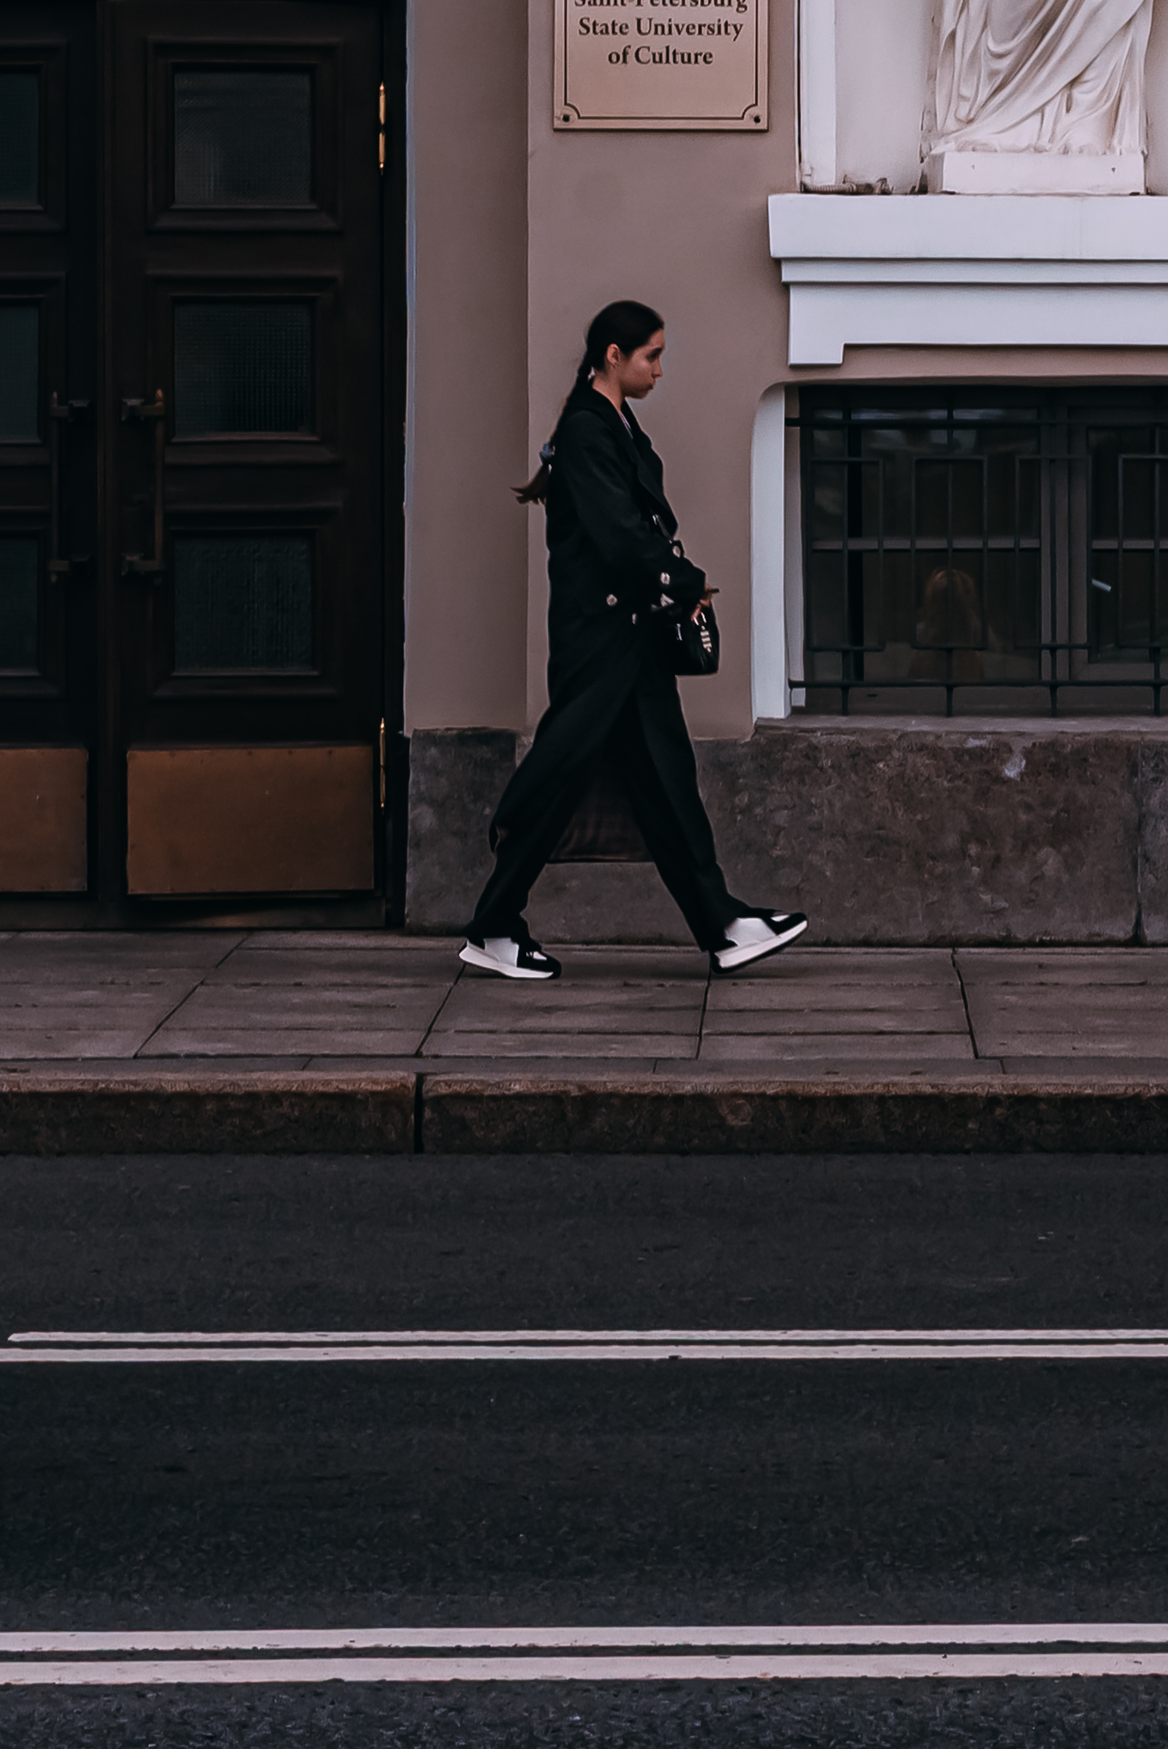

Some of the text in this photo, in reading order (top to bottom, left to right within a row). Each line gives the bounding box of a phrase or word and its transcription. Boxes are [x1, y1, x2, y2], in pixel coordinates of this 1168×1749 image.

[578, 17, 744, 41] State University
[608, 45, 713, 65] of Culture
